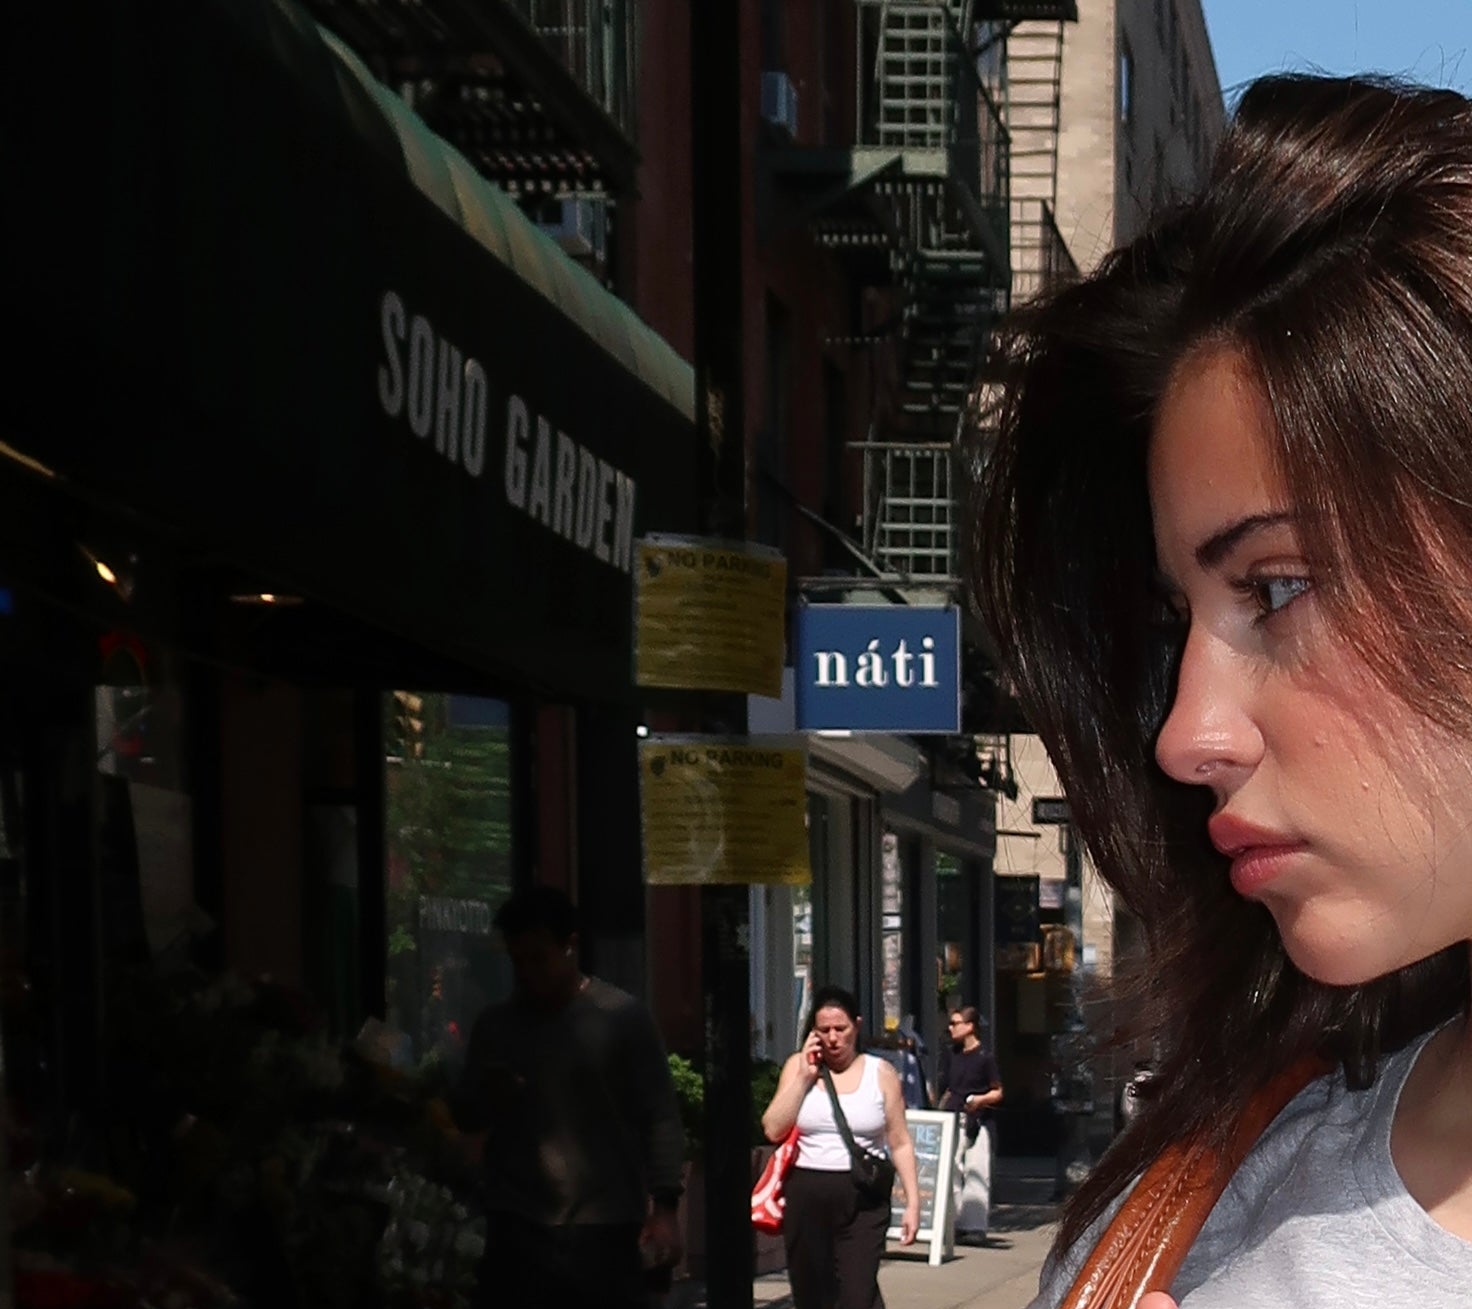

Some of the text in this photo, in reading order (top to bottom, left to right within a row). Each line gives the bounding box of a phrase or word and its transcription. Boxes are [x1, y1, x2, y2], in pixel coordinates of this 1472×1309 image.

[377, 290, 636, 573] SOHO GARDEN
[667, 551, 696, 569] NO
[813, 636, 939, 688] náti
[670, 749, 784, 769] NO PARKING
